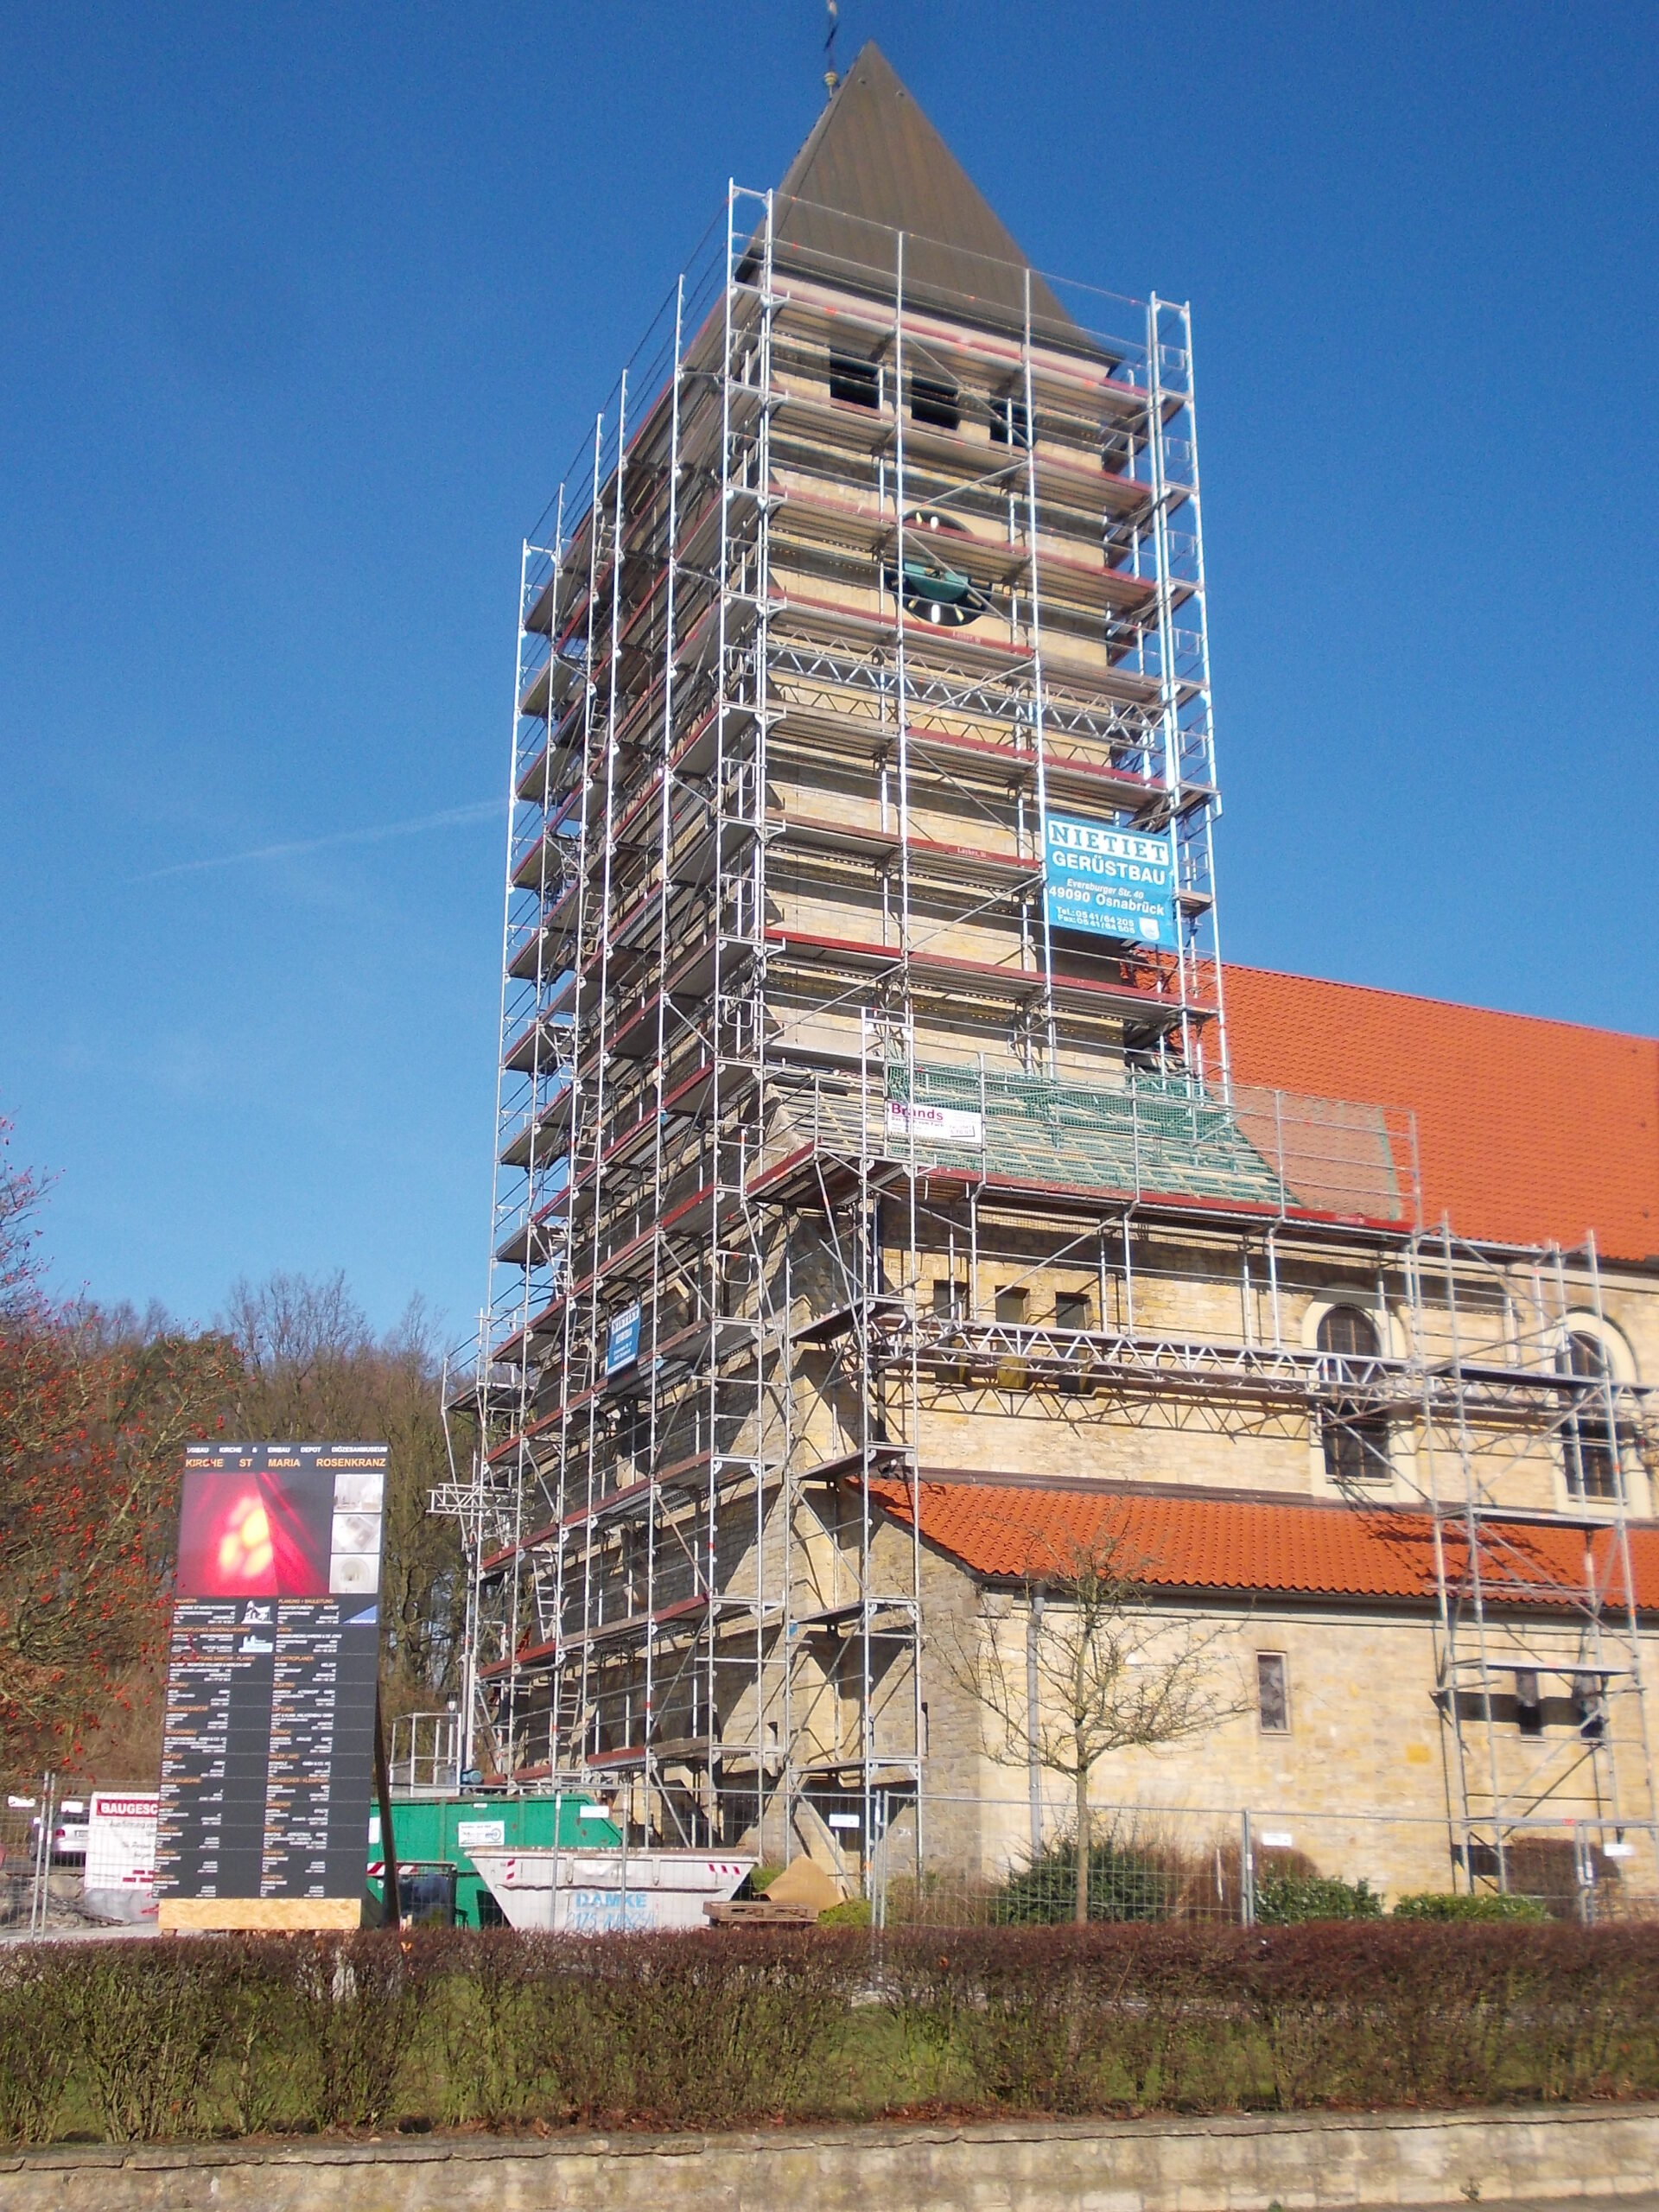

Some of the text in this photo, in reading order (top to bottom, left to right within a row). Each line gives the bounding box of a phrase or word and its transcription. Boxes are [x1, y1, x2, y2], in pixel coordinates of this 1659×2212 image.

[1051, 824, 1166, 861] NIETIET
[1052, 850, 1166, 886] GERÜSTBAU
[1048, 886, 1165, 916] 49090 Osnabrück
[1066, 878, 1144, 899] Eversburger Str. 40
[238, 1459, 253, 1467] ST
[268, 1459, 301, 1467] MARIA
[316, 1459, 386, 1467] ROSENKRANZ
[575, 1893, 647, 1908] DAMKE
